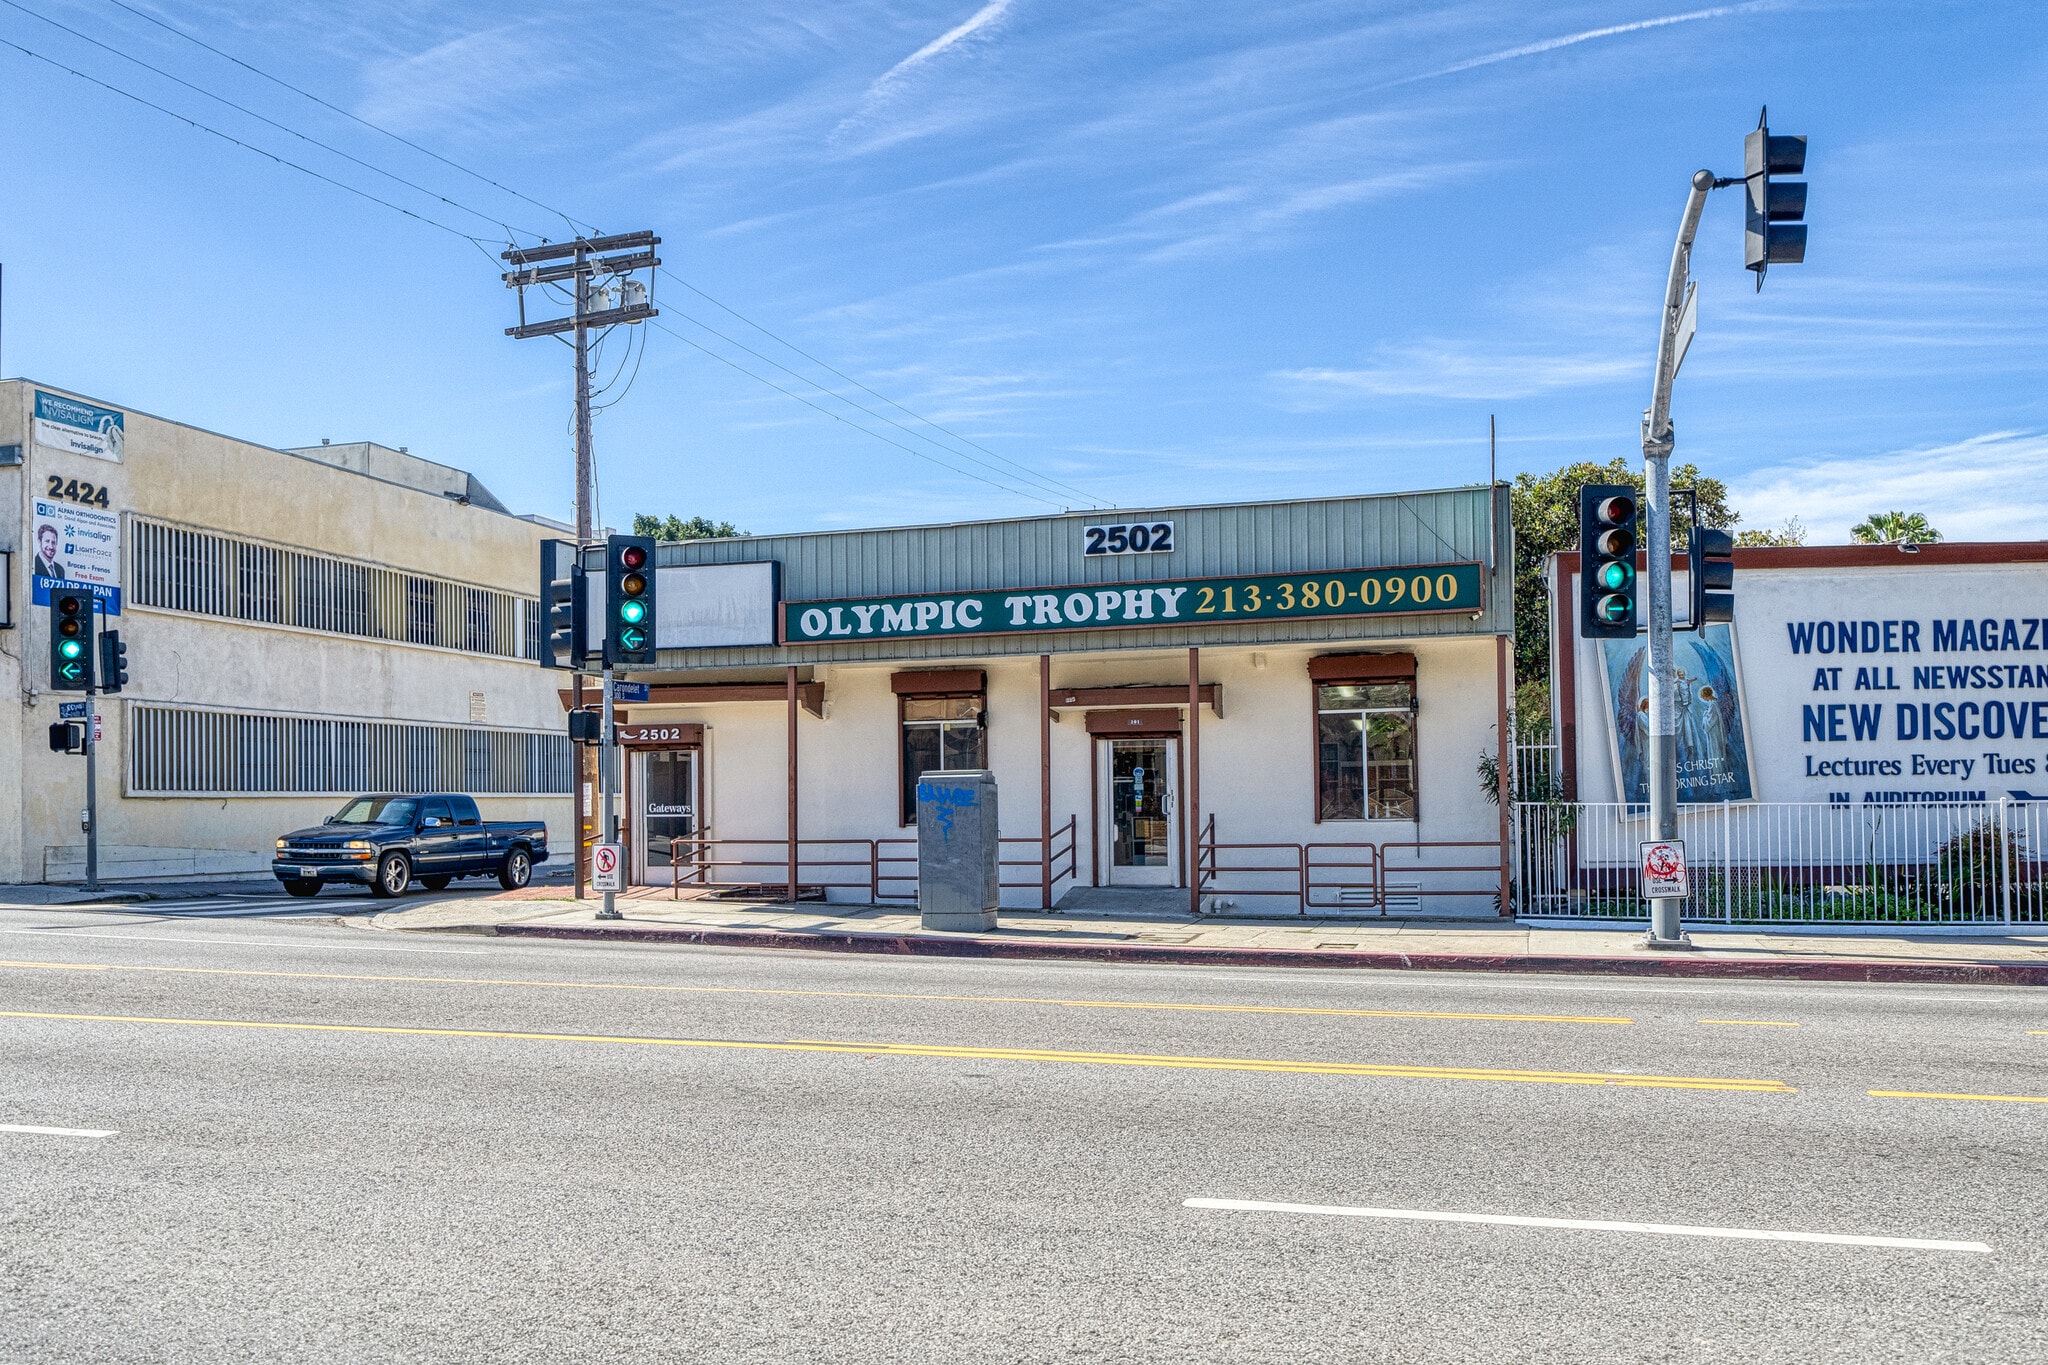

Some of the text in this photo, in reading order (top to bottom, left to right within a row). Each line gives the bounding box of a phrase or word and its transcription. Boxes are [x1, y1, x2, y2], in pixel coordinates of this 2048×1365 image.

[42, 397, 94, 416] WE RECOMMEND
[42, 406, 94, 426] INVISALIGN
[70, 439, 104, 454] invisalign
[48, 475, 110, 508] 2424
[58, 507, 116, 524] ALPAN ORTHODONTICS
[77, 528, 112, 542] invisalign
[1085, 524, 1172, 556] 2502
[67, 561, 111, 574] Braces Frenos
[40, 577, 64, 589] (877)
[89, 574, 104, 582] Exam
[800, 599, 983, 637] OLYMPIC
[1004, 587, 1188, 626] TROPHY
[1787, 620, 1920, 654] WONDER
[1812, 665, 2048, 691] AT ALL NEWSSTAN
[614, 682, 640, 694] Carondelet
[1803, 701, 2048, 742] NEW DISCOVE
[640, 728, 680, 740] 2502
[1805, 755, 1902, 778] Lectures
[1911, 753, 1975, 780] Every
[1983, 752, 2036, 775] Tues
[1710, 772, 1736, 786] STAR
[1829, 790, 1986, 809] IN AUDITORIUM
[648, 803, 691, 815] Gateways
[1652, 886, 1681, 894] CROSSWALK
